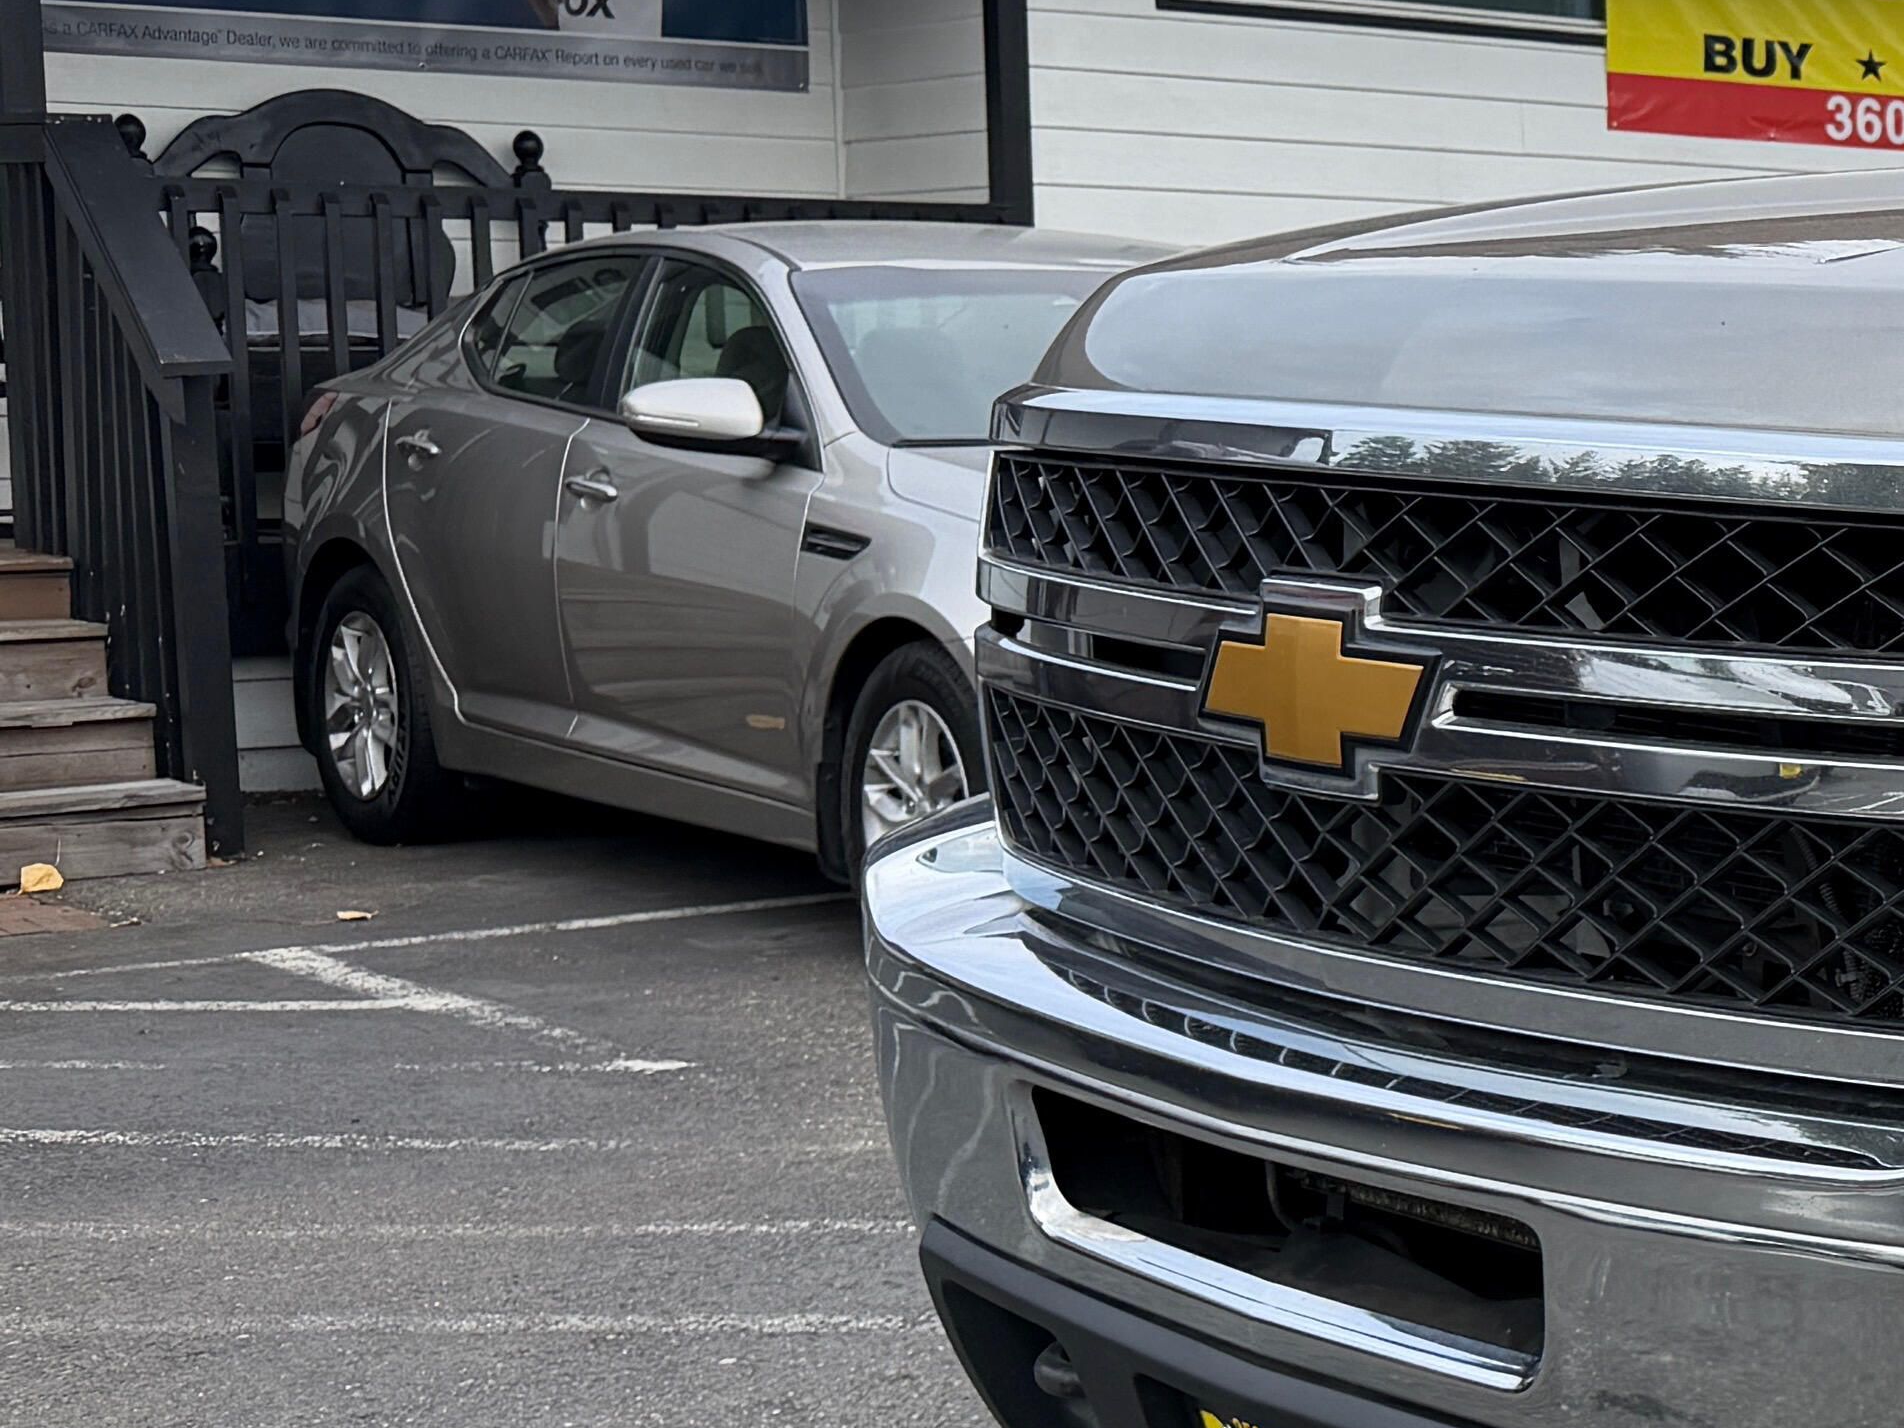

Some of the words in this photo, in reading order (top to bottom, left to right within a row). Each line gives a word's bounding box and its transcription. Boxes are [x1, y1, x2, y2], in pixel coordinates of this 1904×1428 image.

[77, 22, 137, 39] CARFAX
[227, 29, 276, 48] Dealer,
[278, 35, 299, 48] we
[304, 37, 327, 51] are
[331, 38, 404, 54] committed
[408, 39, 422, 54] to
[425, 41, 477, 62] offering
[481, 49, 490, 60] a
[555, 48, 599, 66] Report
[602, 54, 619, 66] on
[623, 55, 657, 70] every
[1704, 34, 1813, 80] BUY
